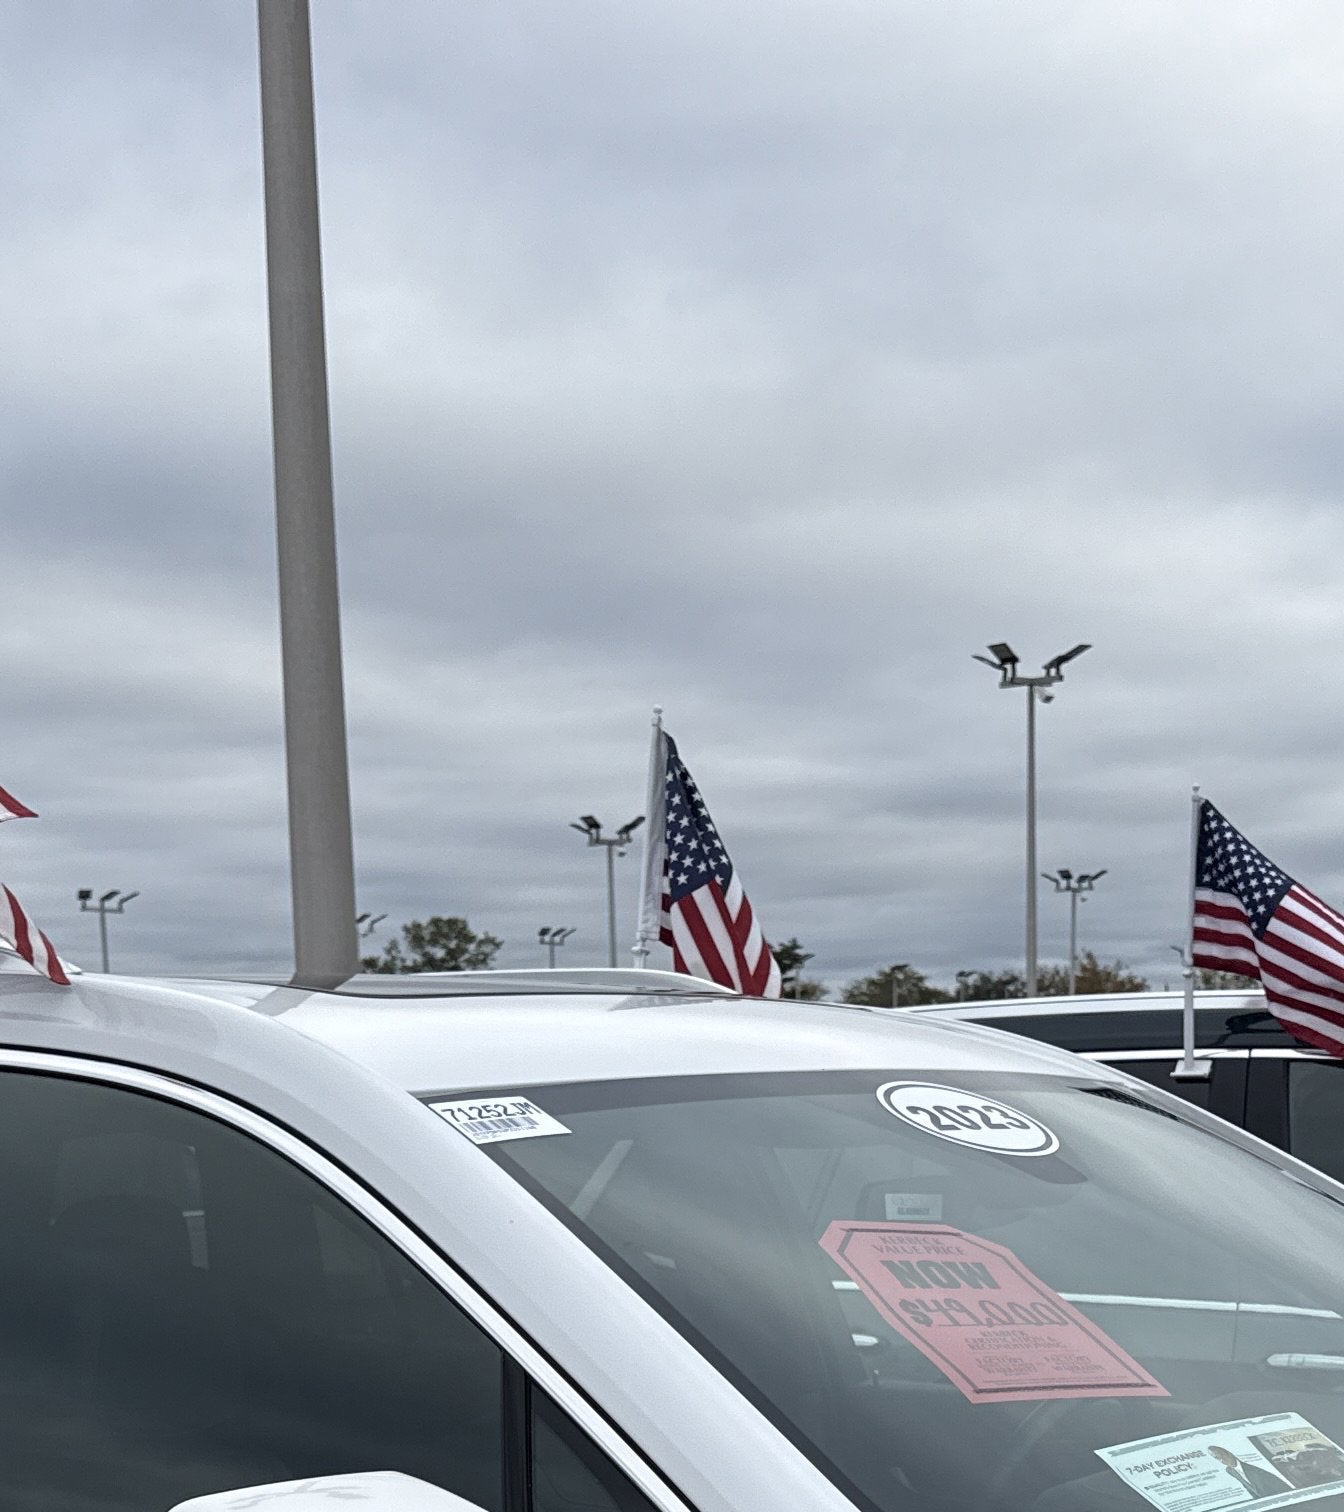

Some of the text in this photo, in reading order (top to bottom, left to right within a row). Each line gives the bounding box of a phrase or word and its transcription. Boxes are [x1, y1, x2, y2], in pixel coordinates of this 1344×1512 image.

[906, 1105, 1030, 1131] 2023
[872, 1245, 966, 1256] VALUE PRICE
[879, 1235, 945, 1246] KERBECK
[879, 1259, 1002, 1290] NOW
[1154, 1449, 1208, 1469] EXCHANGE
